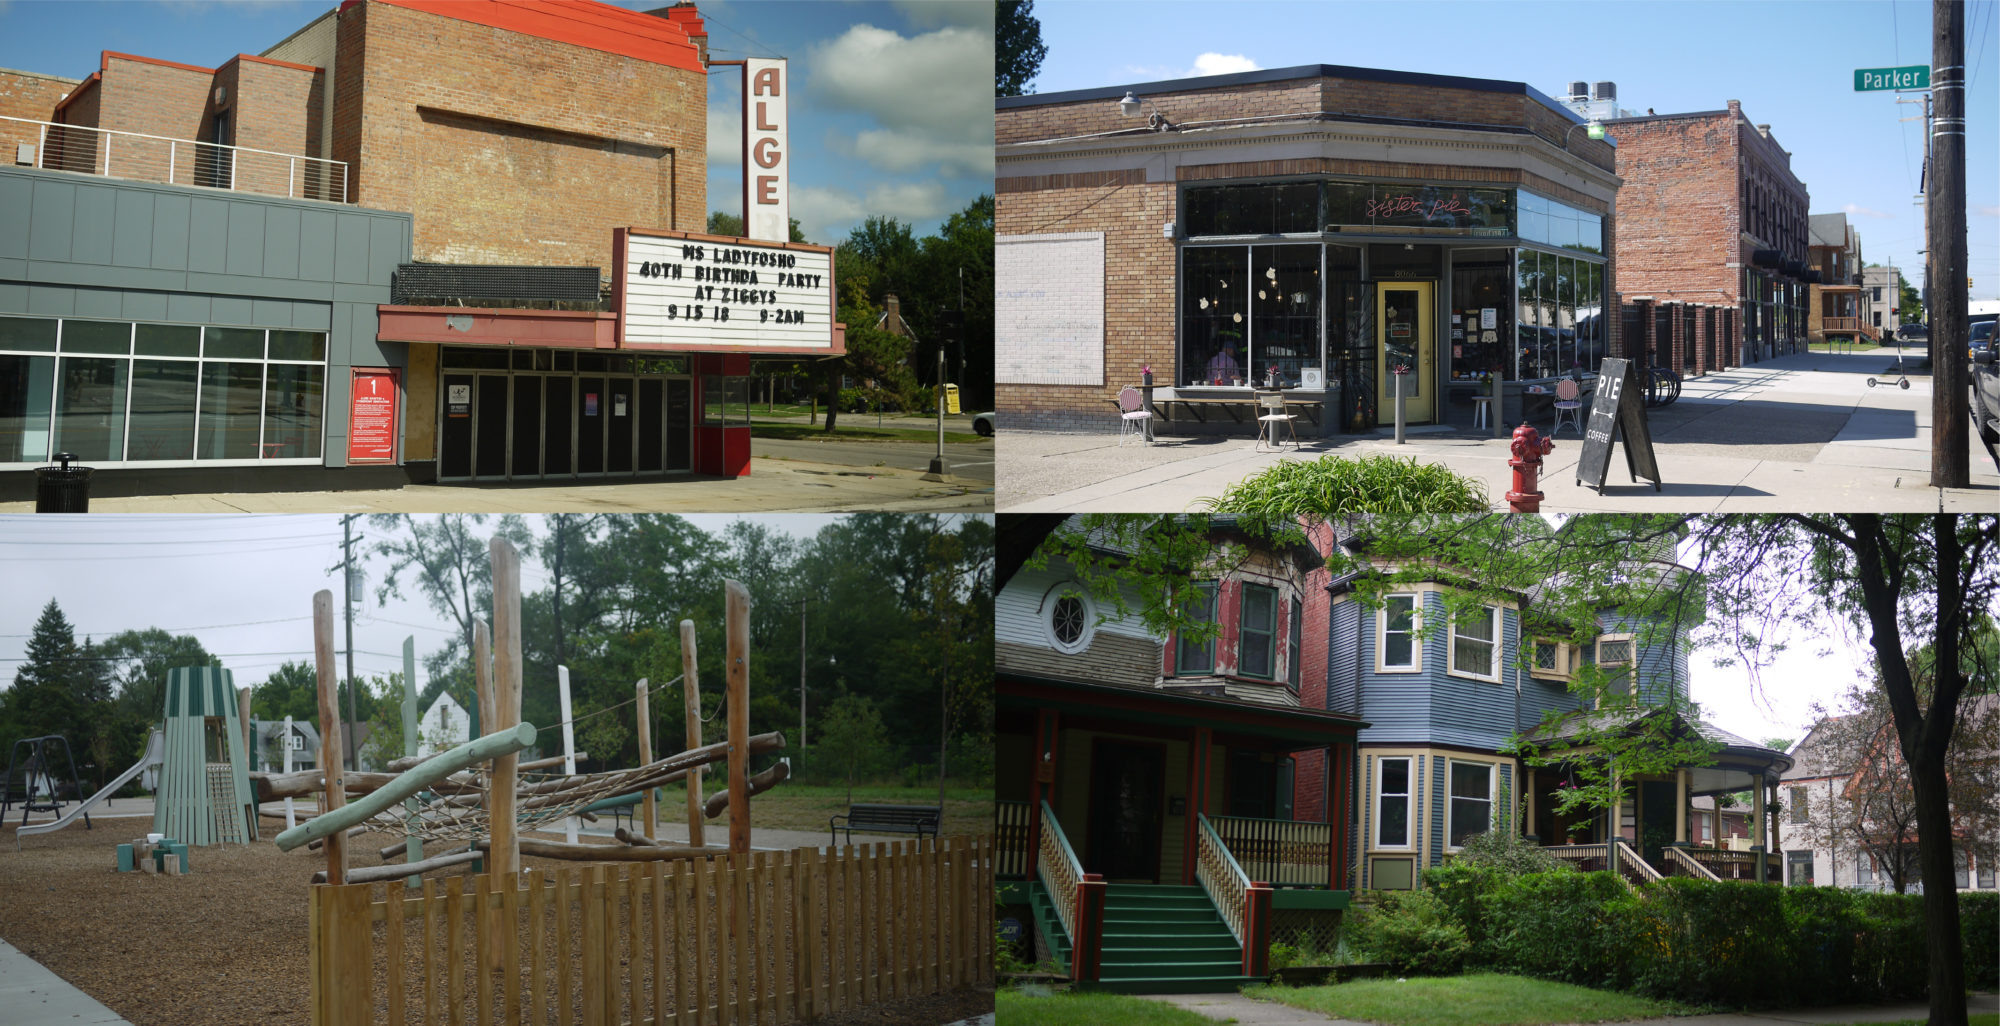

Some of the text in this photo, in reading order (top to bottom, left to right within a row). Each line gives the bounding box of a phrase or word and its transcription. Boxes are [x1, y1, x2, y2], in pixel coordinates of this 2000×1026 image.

[1864, 70, 1920, 88] Parker
[1367, 193, 1471, 219] sister pie
[682, 244, 796, 268] MS LADYFOSHO
[639, 261, 821, 288] 40TH BIRTHDA PARTY
[695, 285, 777, 304] AT ZIGGYS
[759, 308, 804, 325] 9-2AM
[370, 379, 377, 395] 1
[1597, 375, 1621, 400] PIE
[1587, 429, 1609, 444] COFFEE
